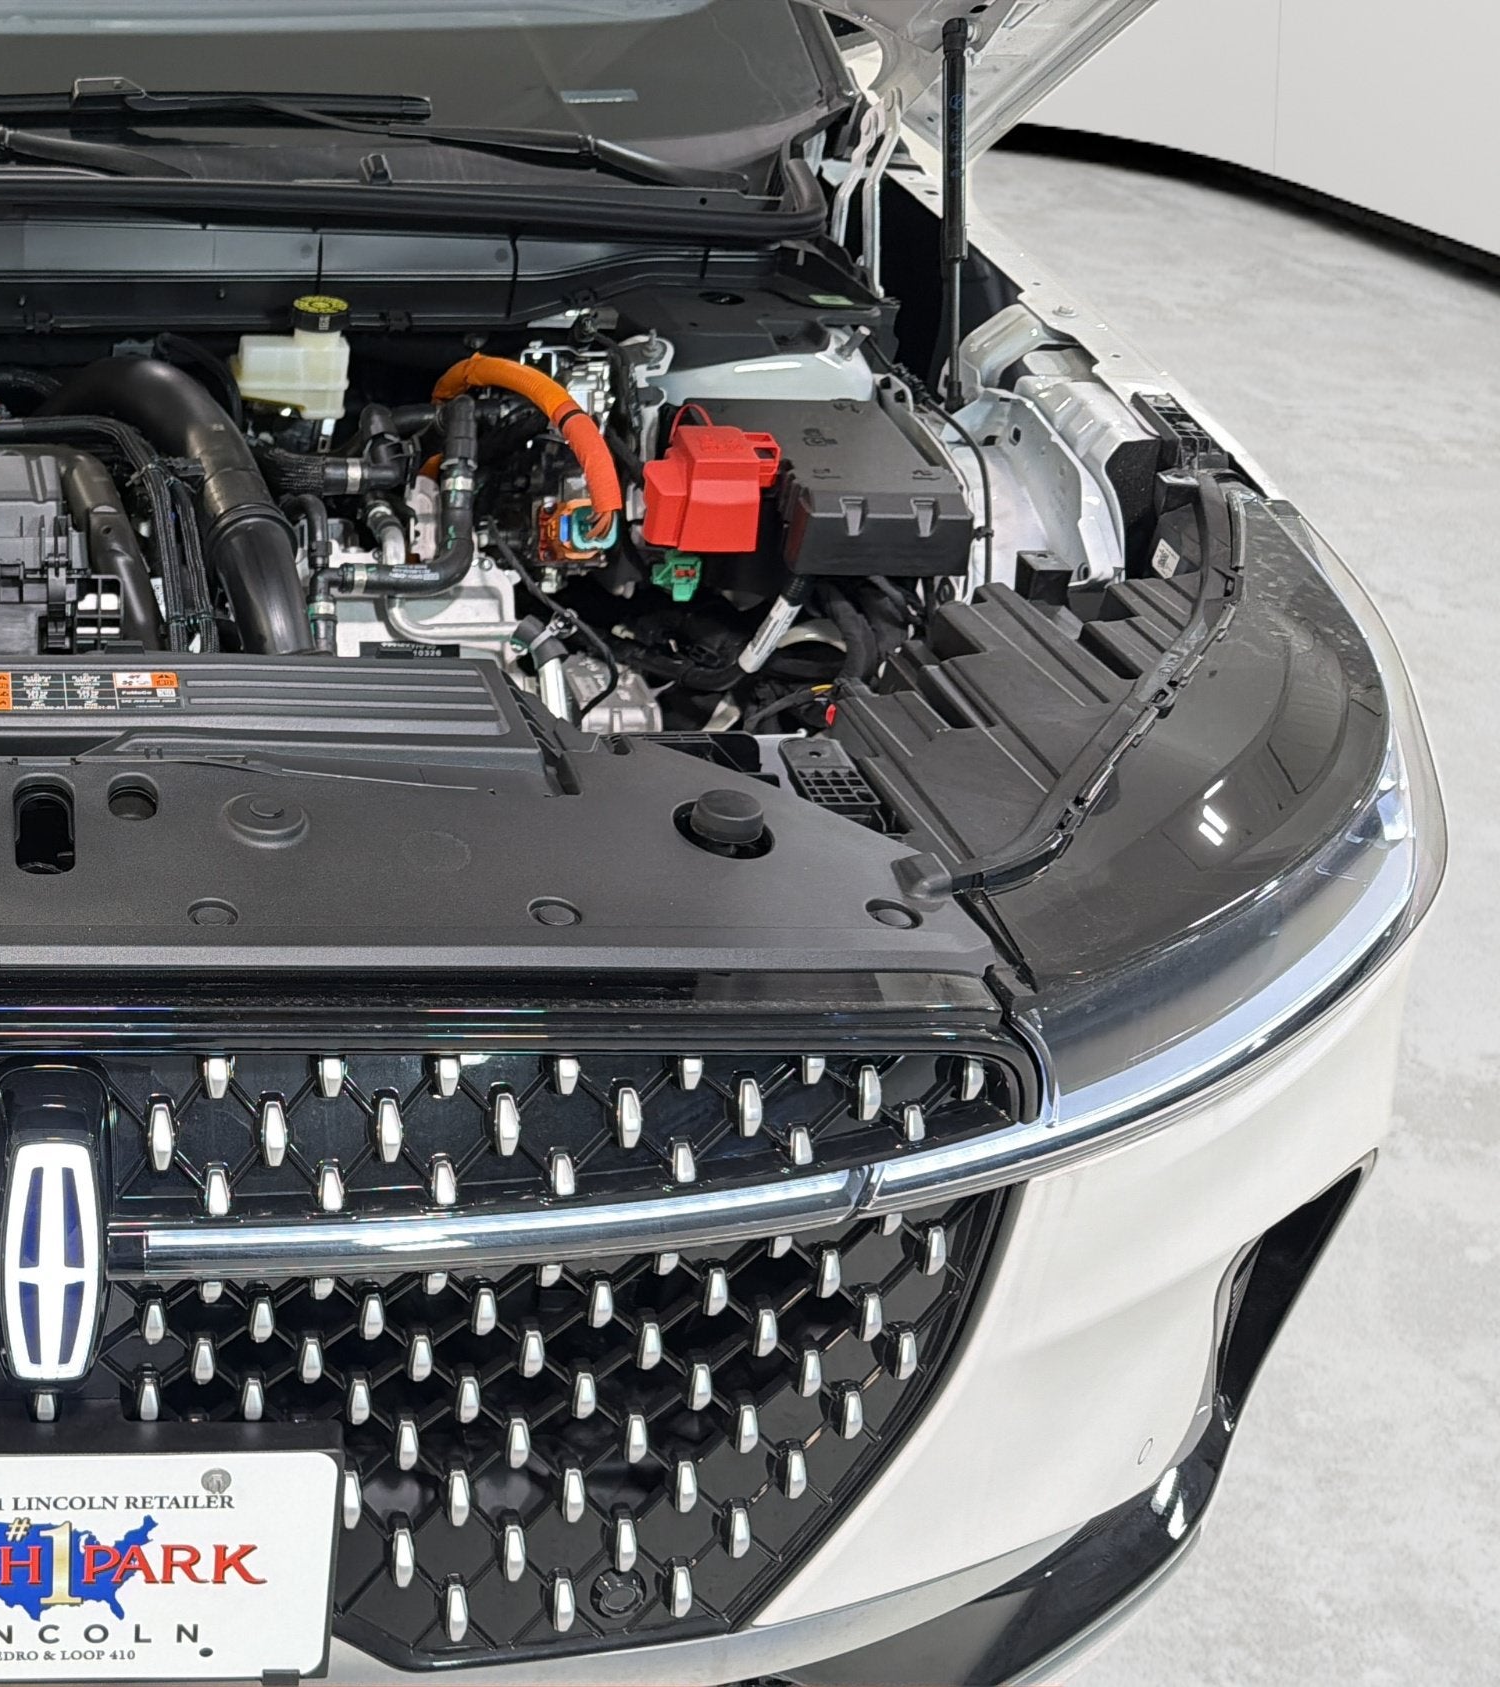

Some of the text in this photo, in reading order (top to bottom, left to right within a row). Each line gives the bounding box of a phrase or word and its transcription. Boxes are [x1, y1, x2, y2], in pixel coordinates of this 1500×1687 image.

[12, 1496, 119, 1511] LINCOLN
[124, 1495, 235, 1510] RETAILER
[82, 1544, 268, 1585] PARK
[43, 1650, 56, 1661] &
[60, 1650, 106, 1661] LOOP
[109, 1649, 136, 1661] 410
